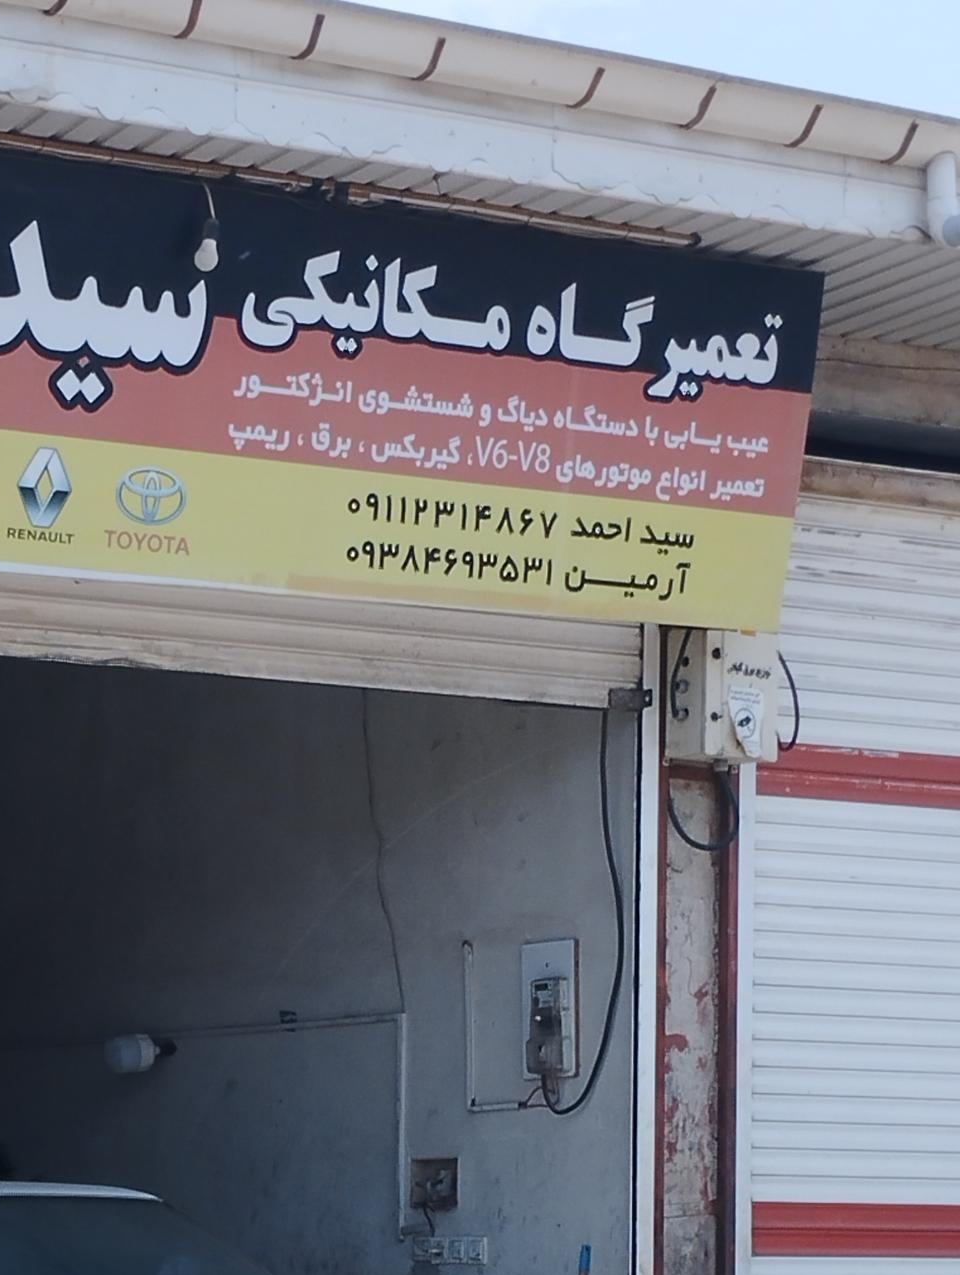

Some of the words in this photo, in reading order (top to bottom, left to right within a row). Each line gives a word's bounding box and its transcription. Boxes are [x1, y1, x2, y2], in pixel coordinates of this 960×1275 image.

[241, 250, 512, 354] مکانیکی
[232, 371, 353, 407] انژکتور
[357, 385, 474, 419] شستشوی
[477, 401, 492, 427] و
[496, 395, 548, 433] دیاگ
[552, 404, 639, 438] دستگاه
[644, 415, 660, 447] با
[227, 420, 291, 452] ریمپ
[310, 421, 352, 459] برق
[370, 433, 461, 470] گیربکس
[663, 421, 722, 454] یابی
[726, 434, 769, 459] عیب
[655, 466, 707, 501] انواع
[709, 476, 765, 502] تعمیر
[347, 492, 559, 539] ۰۹۱۱۲۳۱۴۸۶۷
[569, 516, 633, 543] احمد
[6, 527, 75, 545] RENAULT
[103, 529, 190, 556] TOYOTA
[639, 523, 696, 555] سید
[345, 540, 554, 586] ۰۹۳۸۴۶۹۳۵۳۱
[563, 562, 692, 601] آرمین
